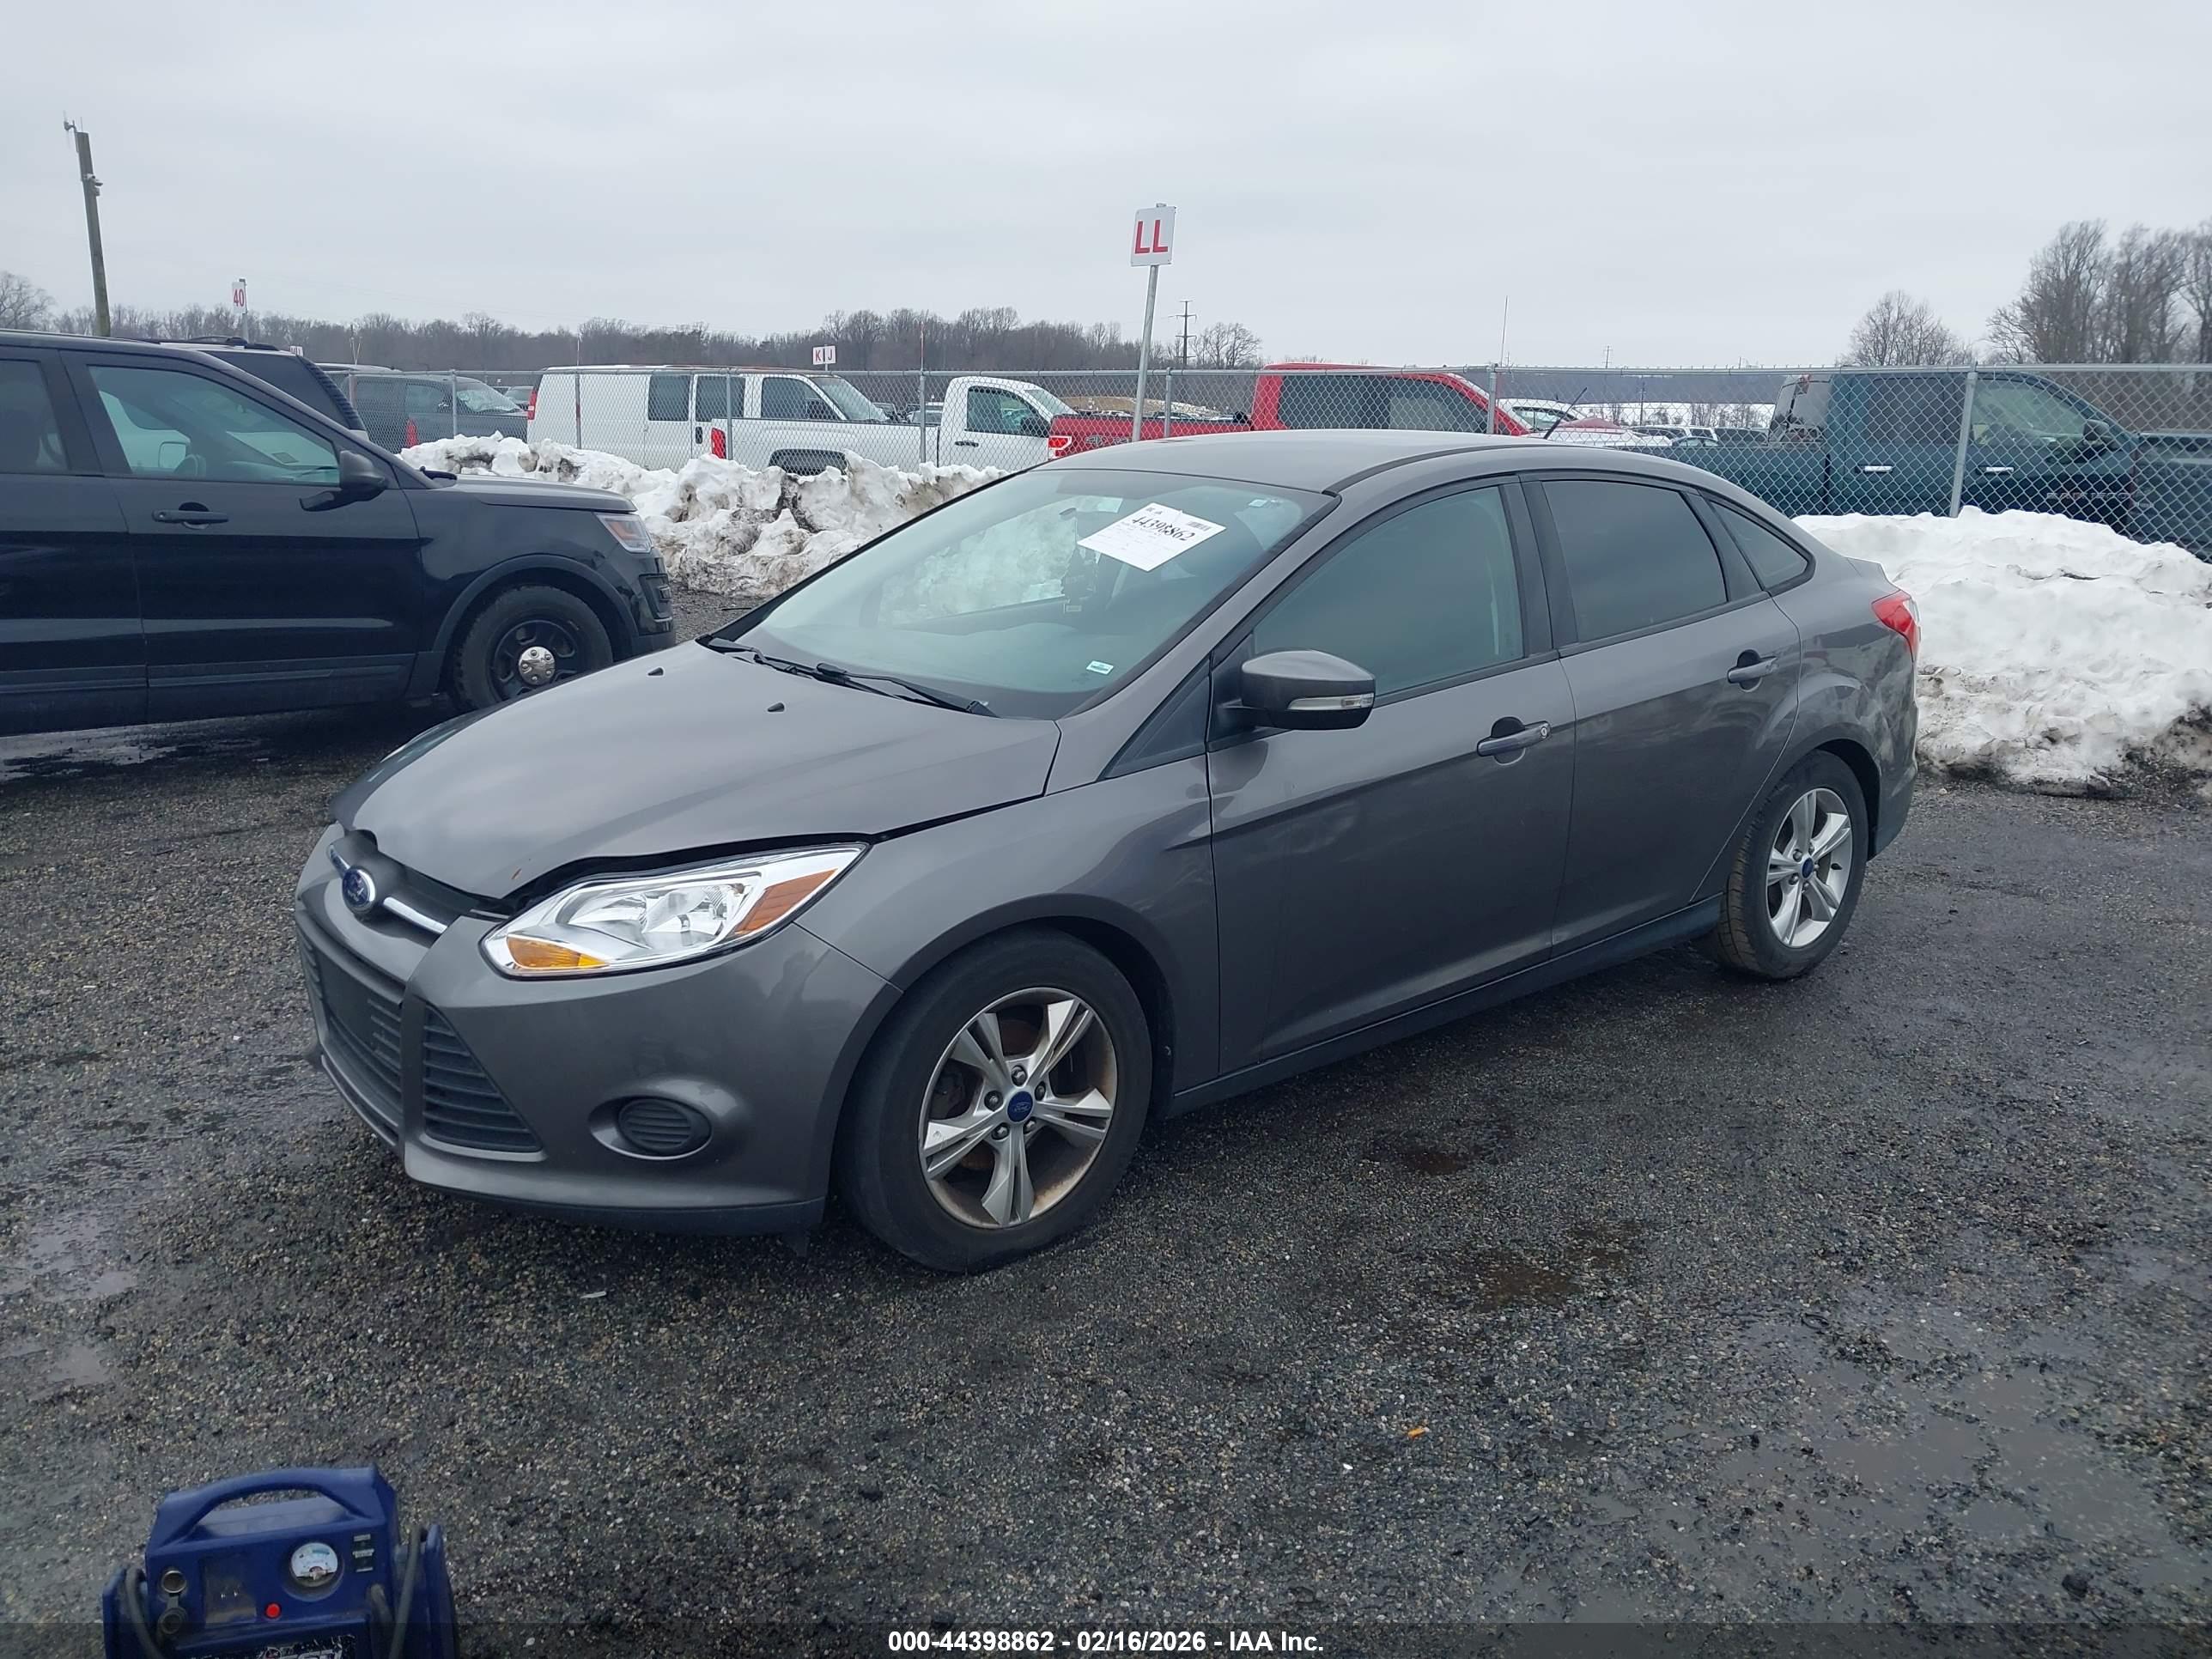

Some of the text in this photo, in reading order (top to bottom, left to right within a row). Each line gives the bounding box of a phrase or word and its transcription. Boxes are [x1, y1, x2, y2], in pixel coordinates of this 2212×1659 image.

[1133, 219, 1169, 254] LL
[233, 288, 245, 307] 40
[815, 349, 822, 362] K
[827, 349, 833, 361] J
